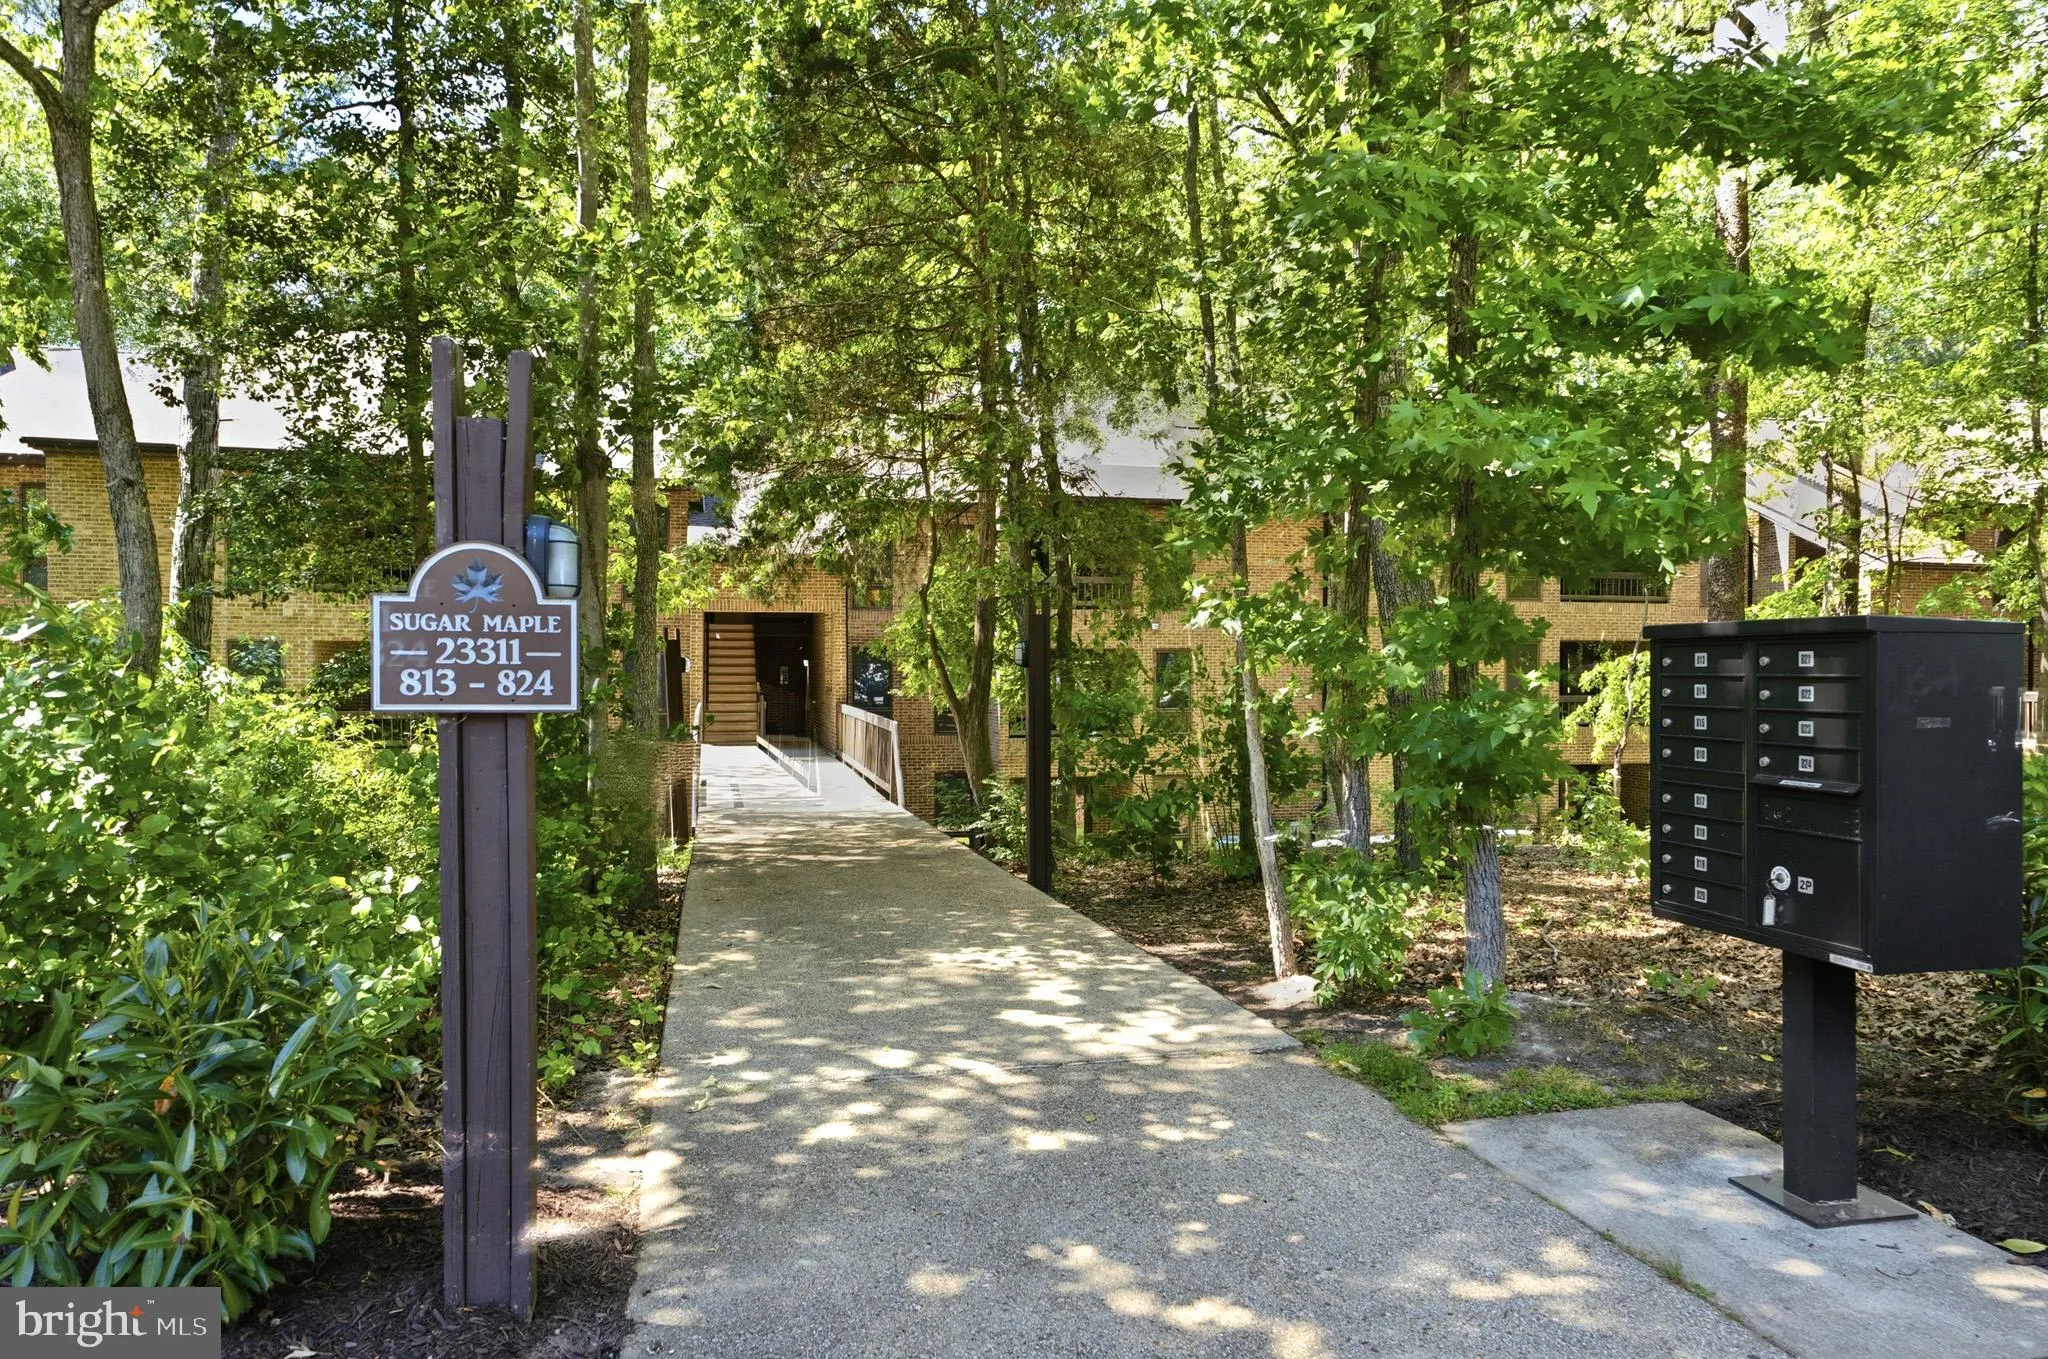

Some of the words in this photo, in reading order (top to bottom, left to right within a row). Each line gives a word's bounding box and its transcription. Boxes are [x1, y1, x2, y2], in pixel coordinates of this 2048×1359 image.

[389, 612, 472, 632] SUGAR
[482, 614, 562, 634] MAPLE
[435, 637, 522, 665] 23311
[399, 668, 457, 696] 813
[496, 669, 554, 696] 824
[1799, 879, 1812, 891] 2P
